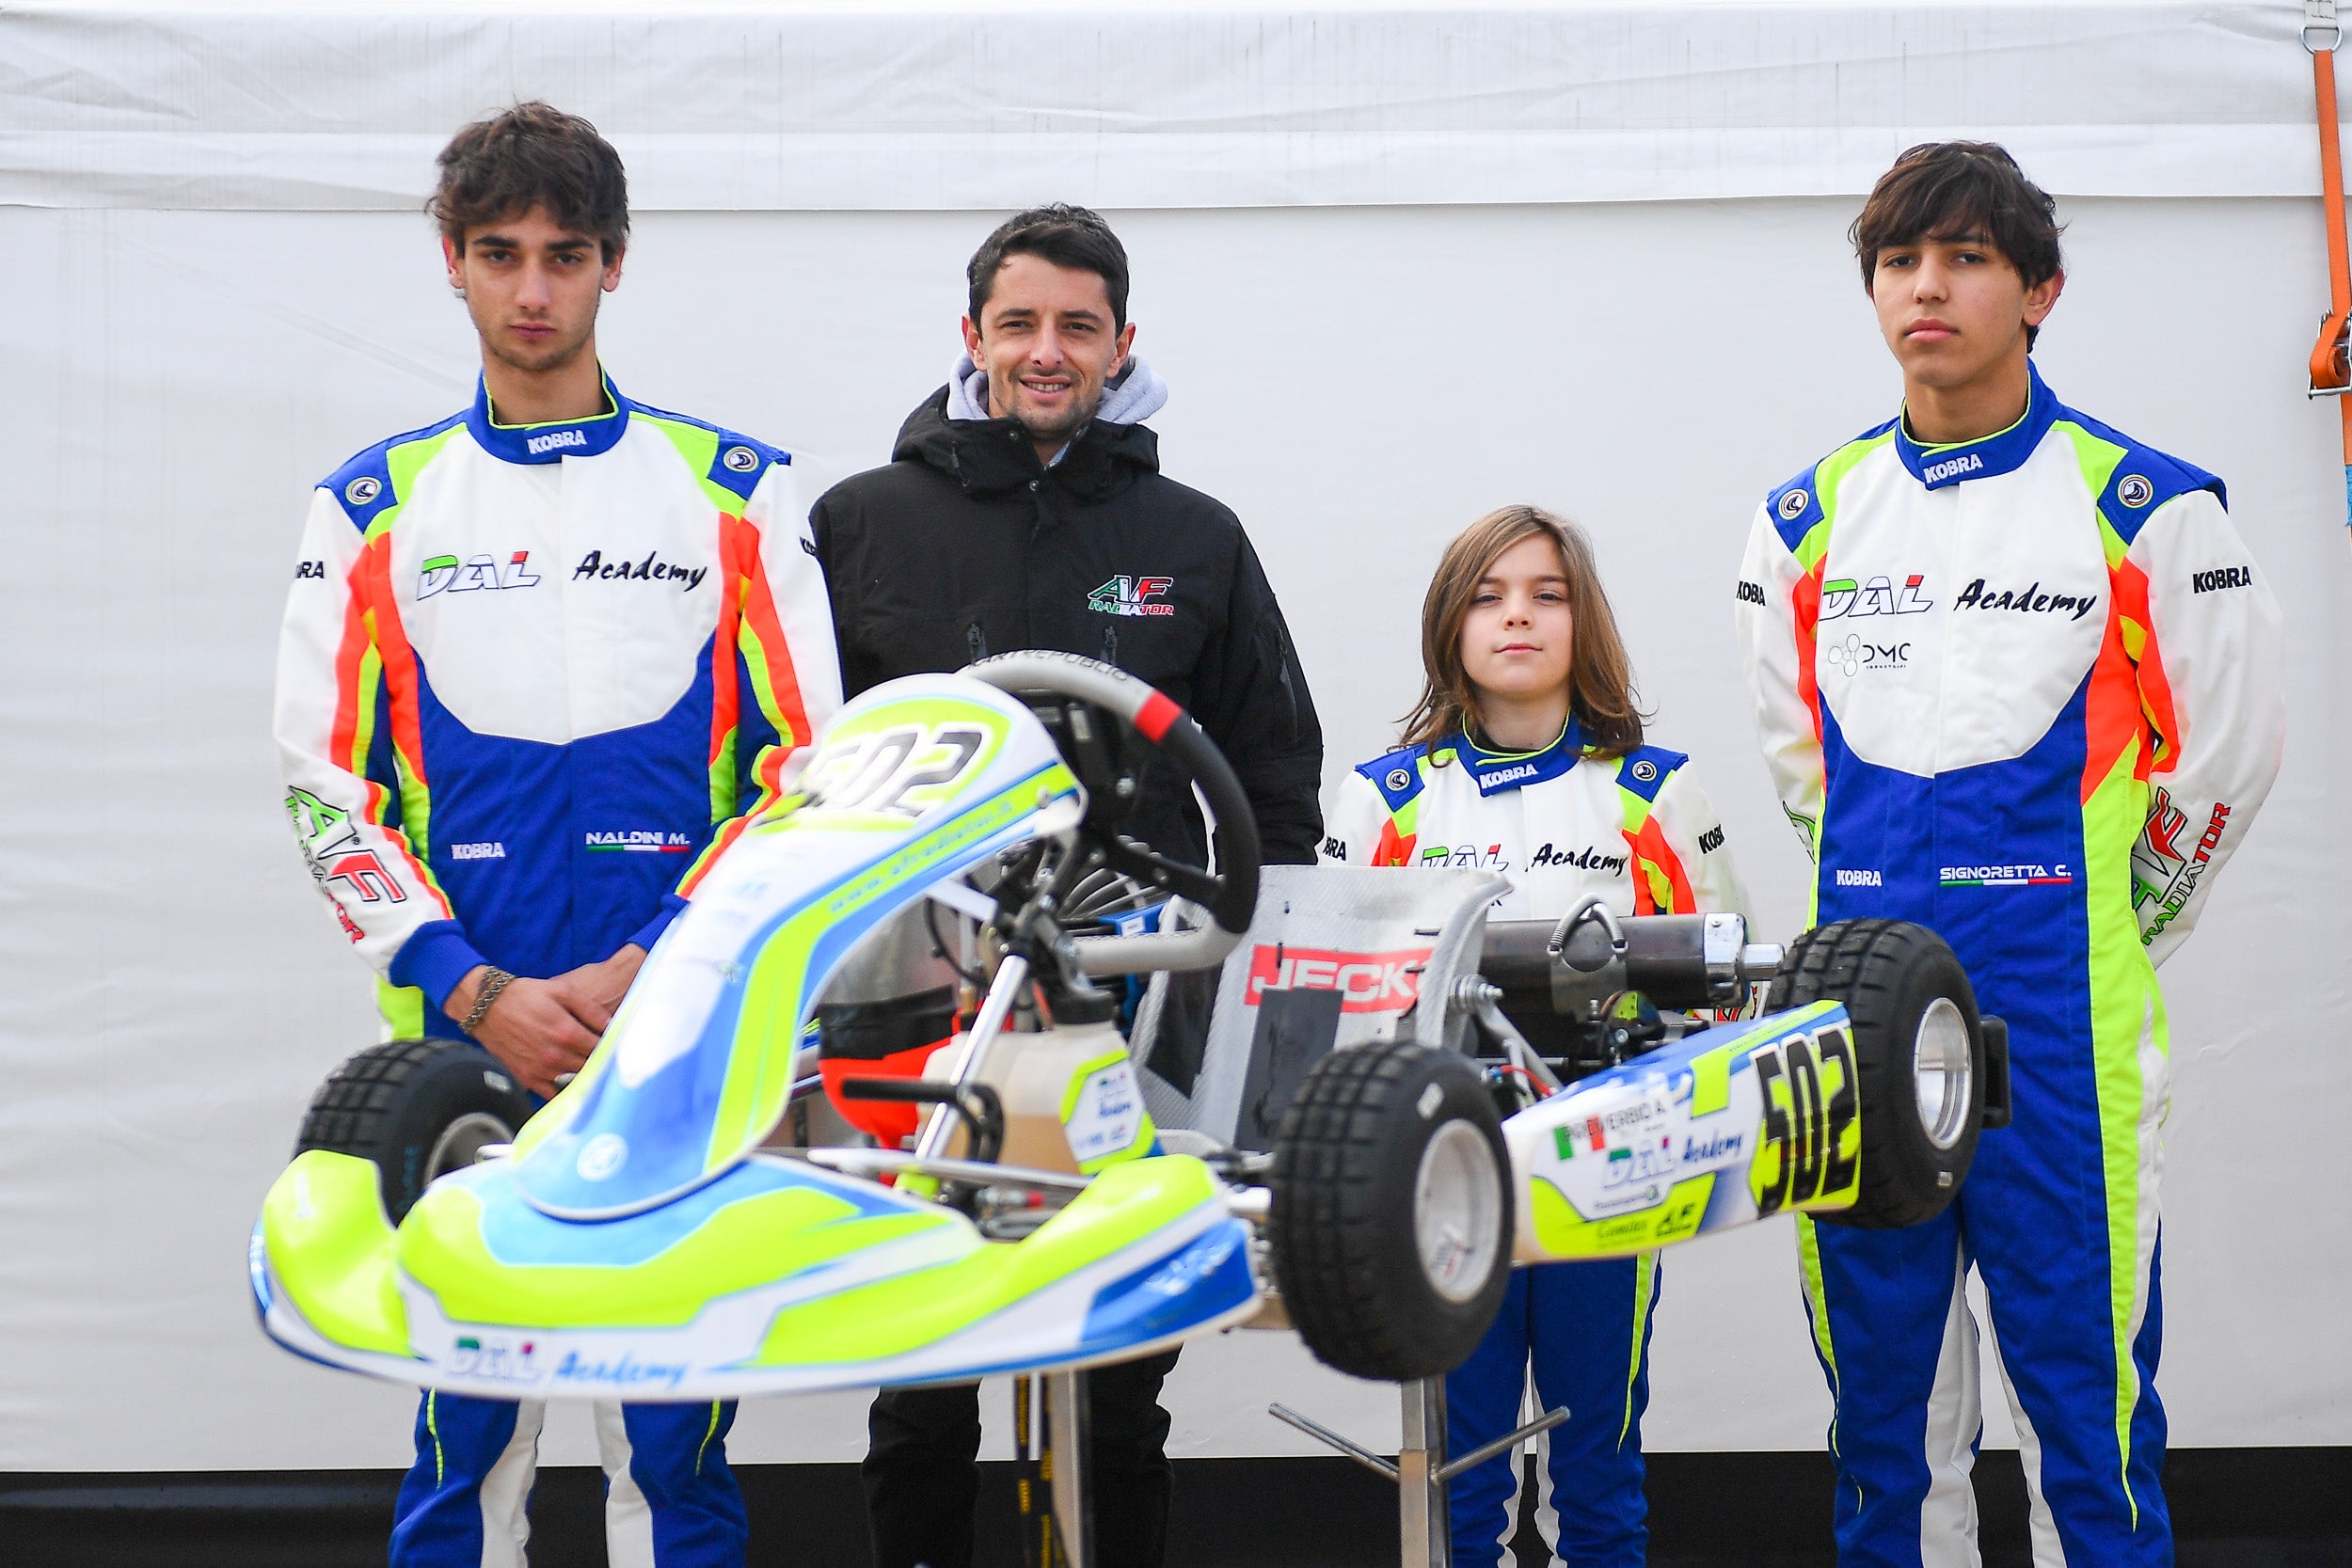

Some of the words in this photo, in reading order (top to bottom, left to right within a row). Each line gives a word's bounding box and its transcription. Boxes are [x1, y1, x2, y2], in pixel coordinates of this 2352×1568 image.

[527, 429, 587, 455] KOBRA
[1924, 453, 1983, 483] KOBRA
[417, 551, 540, 601] DAL
[573, 549, 707, 592] Academy
[2193, 566, 2252, 594] KOBRA
[1088, 599, 1174, 616] RADIATOR
[1820, 575, 1933, 622] DAL
[1954, 578, 2097, 621] Academy
[1480, 764, 1538, 789] KOBRA
[452, 842, 505, 860] KOBRA
[585, 830, 664, 846] NALDINI
[668, 832, 691, 846] M.
[1525, 843, 1629, 877] Academy
[1940, 864, 2047, 880] SIGNORETTA
[2054, 864, 2073, 879] C.
[2140, 801, 2232, 946] RADIATOR
[1836, 868, 1882, 886] KOBRA
[1756, 1029, 1859, 1220] 502
[556, 1350, 689, 1391] Academy
